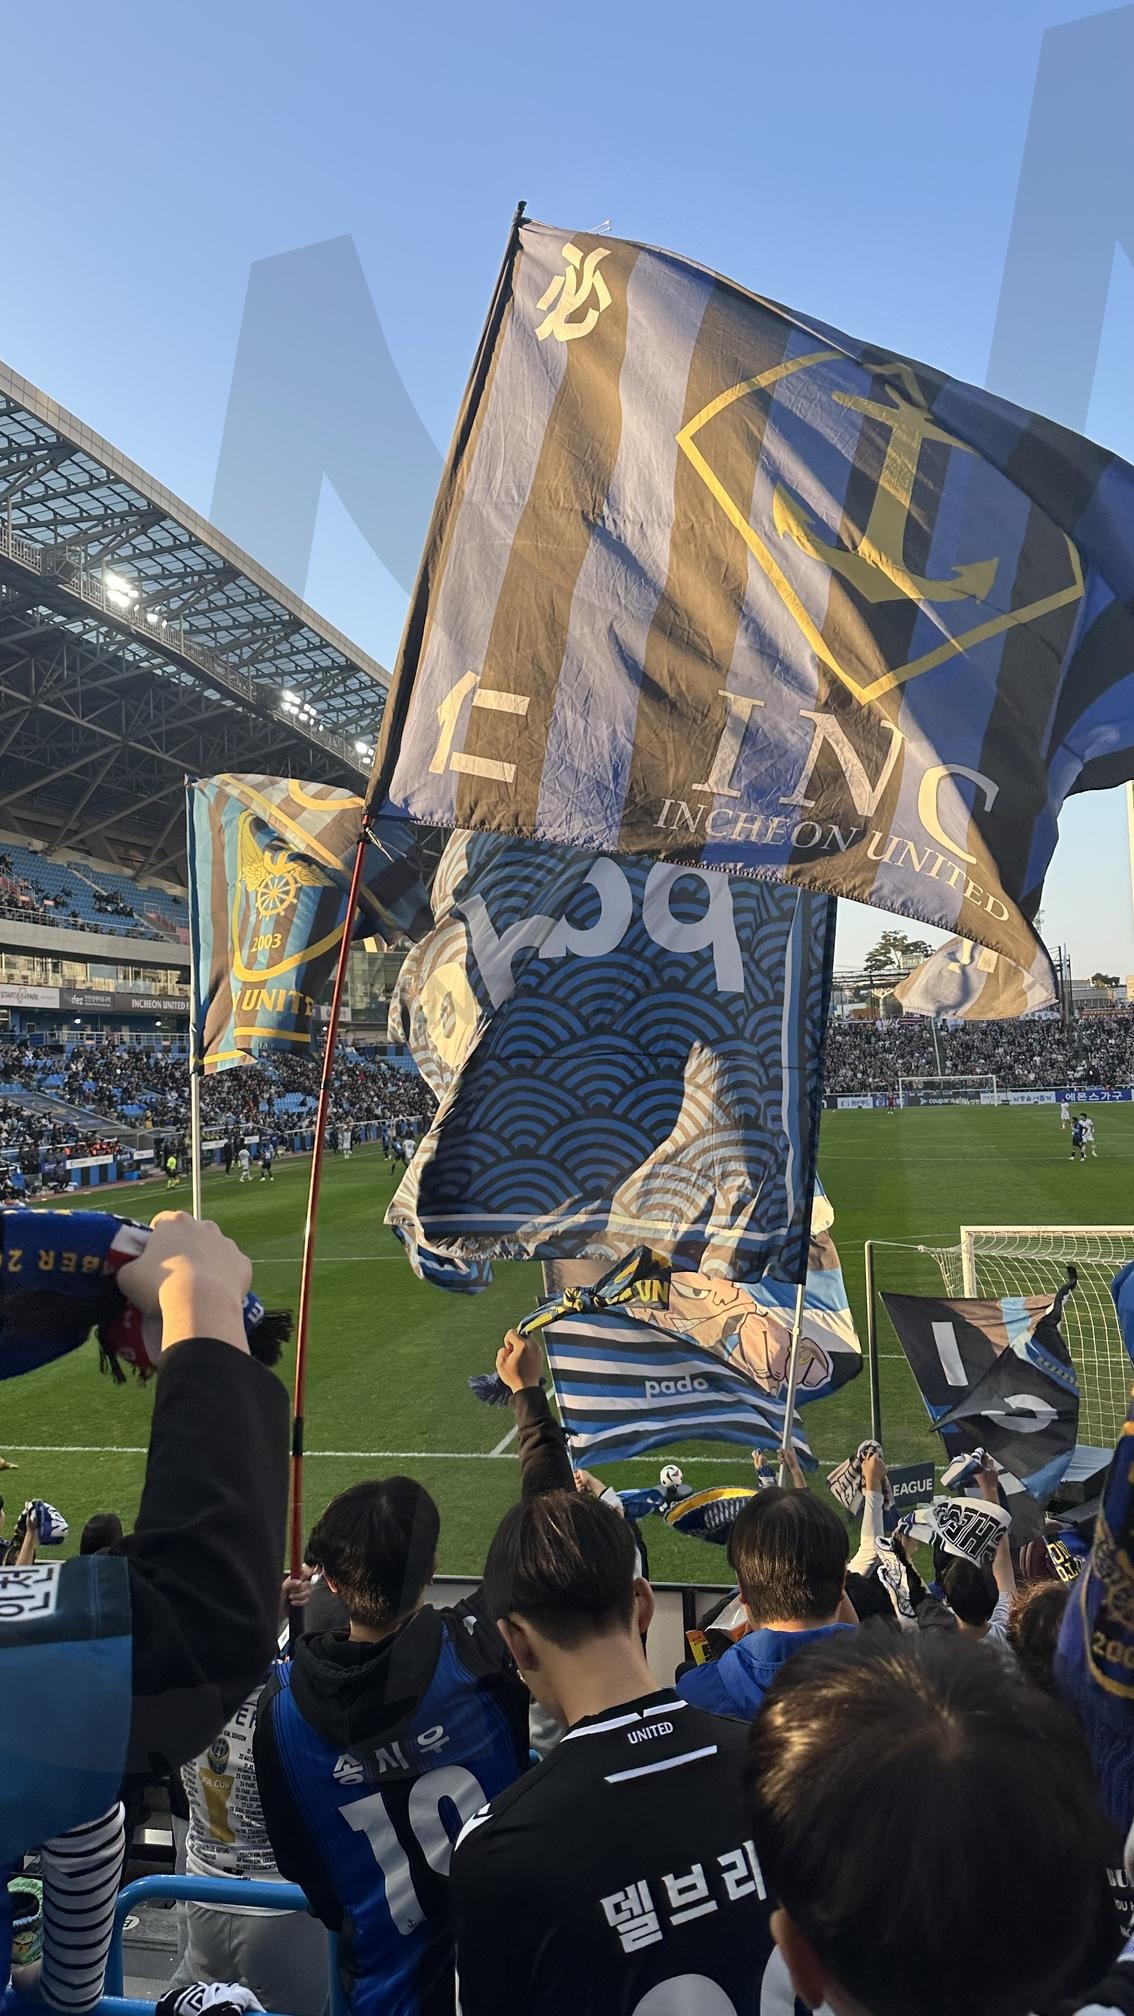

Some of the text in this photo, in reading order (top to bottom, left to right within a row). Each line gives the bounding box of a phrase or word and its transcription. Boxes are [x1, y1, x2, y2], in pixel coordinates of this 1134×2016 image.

[653, 798, 1009, 921] INCHEON UNITED
[250, 933, 282, 953] 2003
[131, 999, 162, 1009] INCHEON
[162, 1000, 186, 1010] UNITED
[644, 1374, 709, 1400] pado
[627, 1721, 674, 1745] UNITED
[332, 1724, 450, 1785] 송시우
[600, 1840, 767, 1954] 델브리
